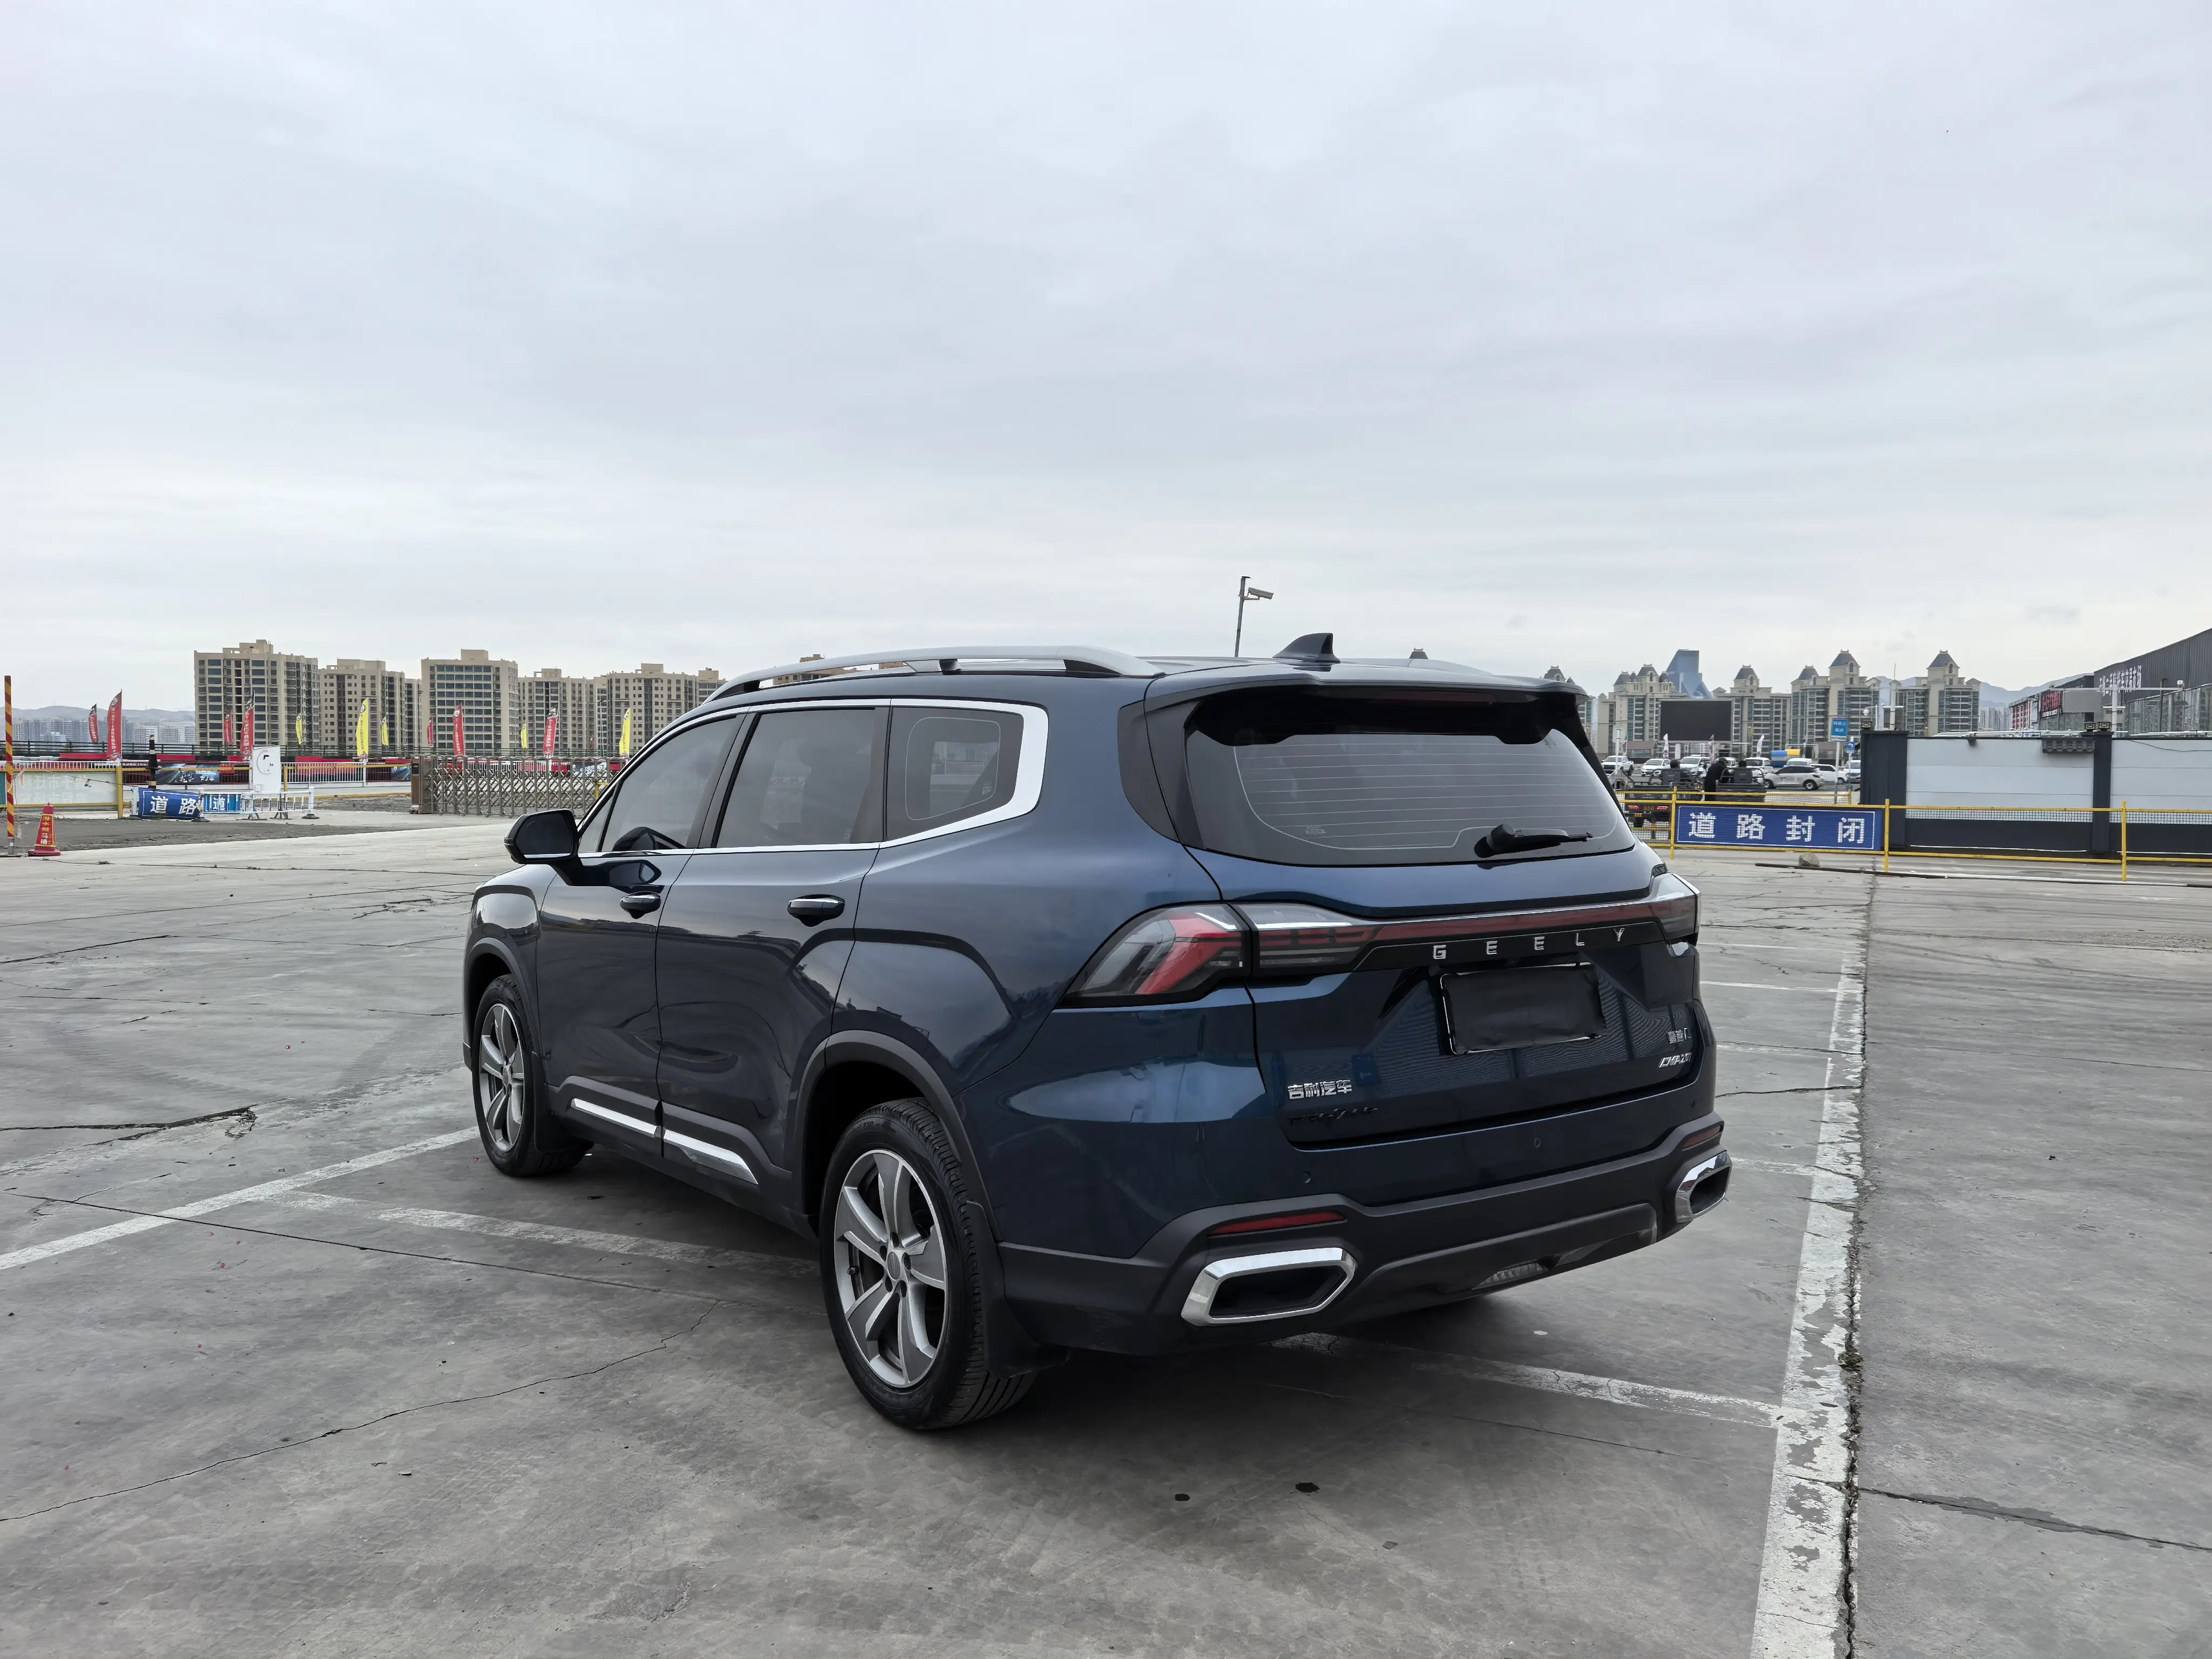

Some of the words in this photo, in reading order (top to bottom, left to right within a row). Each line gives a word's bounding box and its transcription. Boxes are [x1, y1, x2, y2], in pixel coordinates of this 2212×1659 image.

[1688, 812, 1865, 844] 道路封闭
[1433, 928, 1625, 960] GEELY
[1287, 1079, 1352, 1100] 吉利汽车
